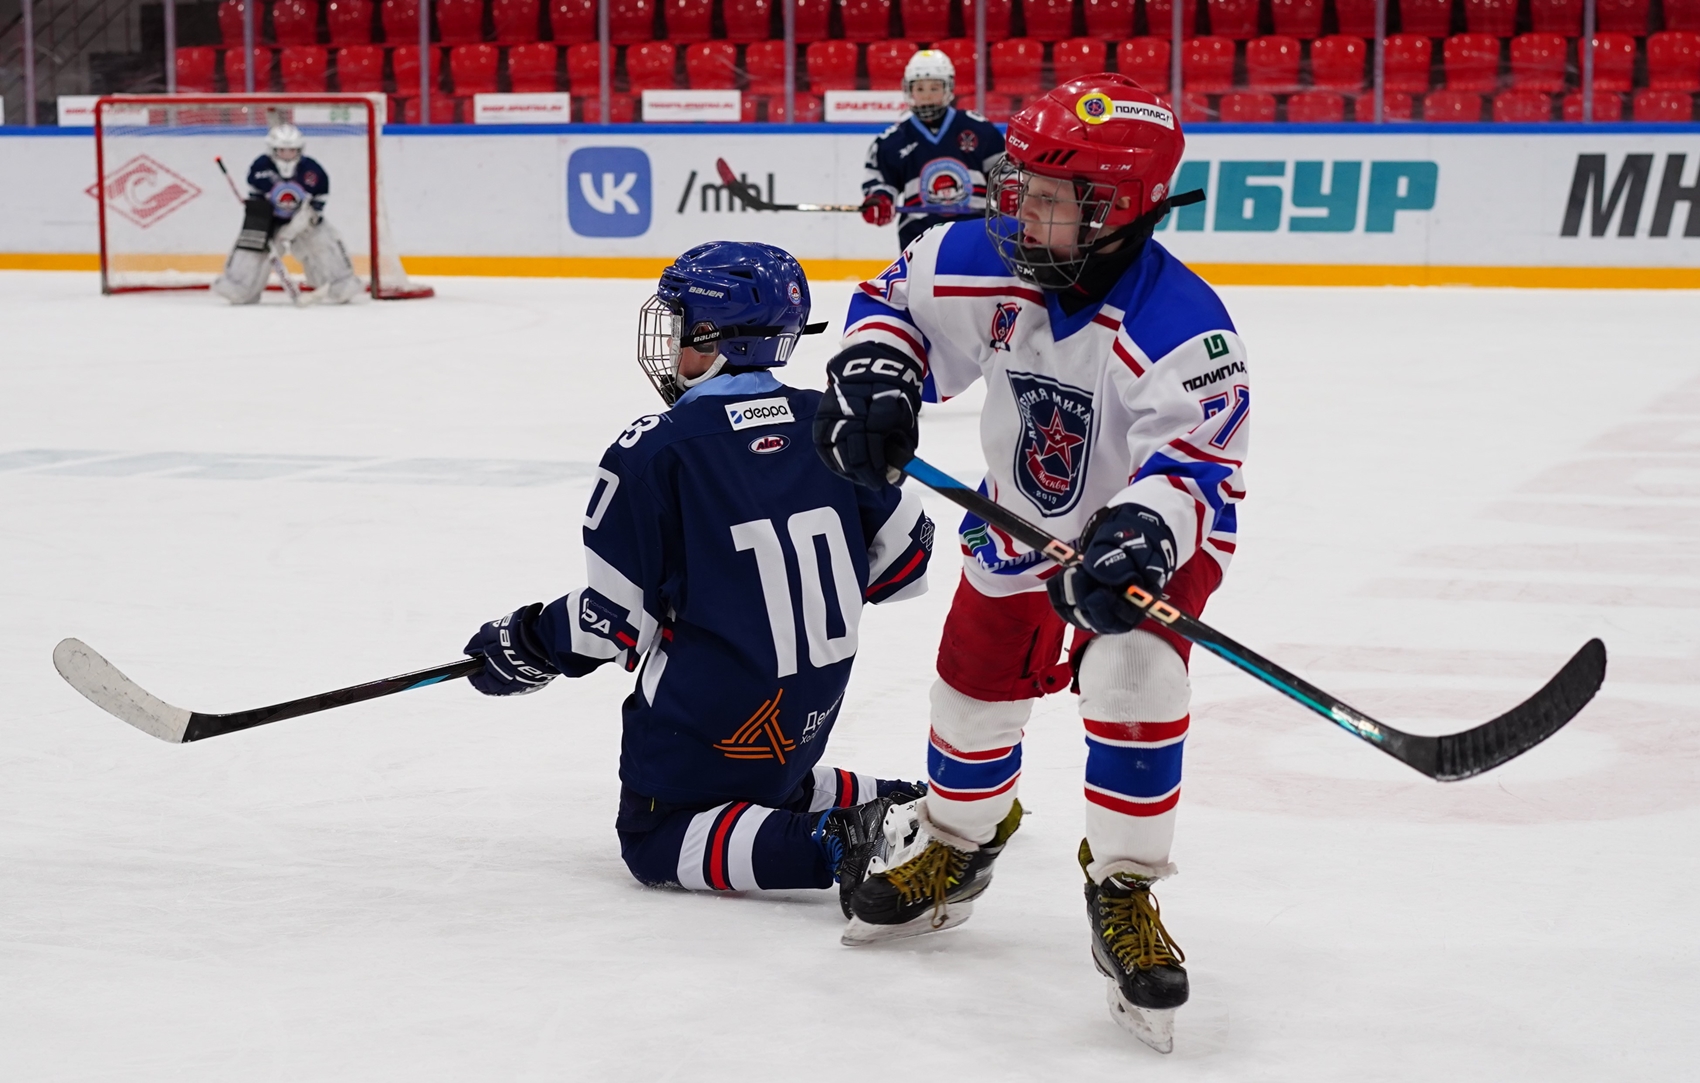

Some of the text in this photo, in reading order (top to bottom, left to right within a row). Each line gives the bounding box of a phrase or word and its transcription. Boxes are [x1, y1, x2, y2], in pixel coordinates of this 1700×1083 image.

[1008, 134, 1029, 151] CCM
[1100, 163, 1132, 171] CM
[578, 171, 640, 215] VK
[1150, 160, 1439, 234] ИБУР
[842, 357, 924, 398] CCM
[743, 403, 788, 420] deppa
[1035, 489, 1058, 505] 2019
[729, 505, 863, 679] 10
